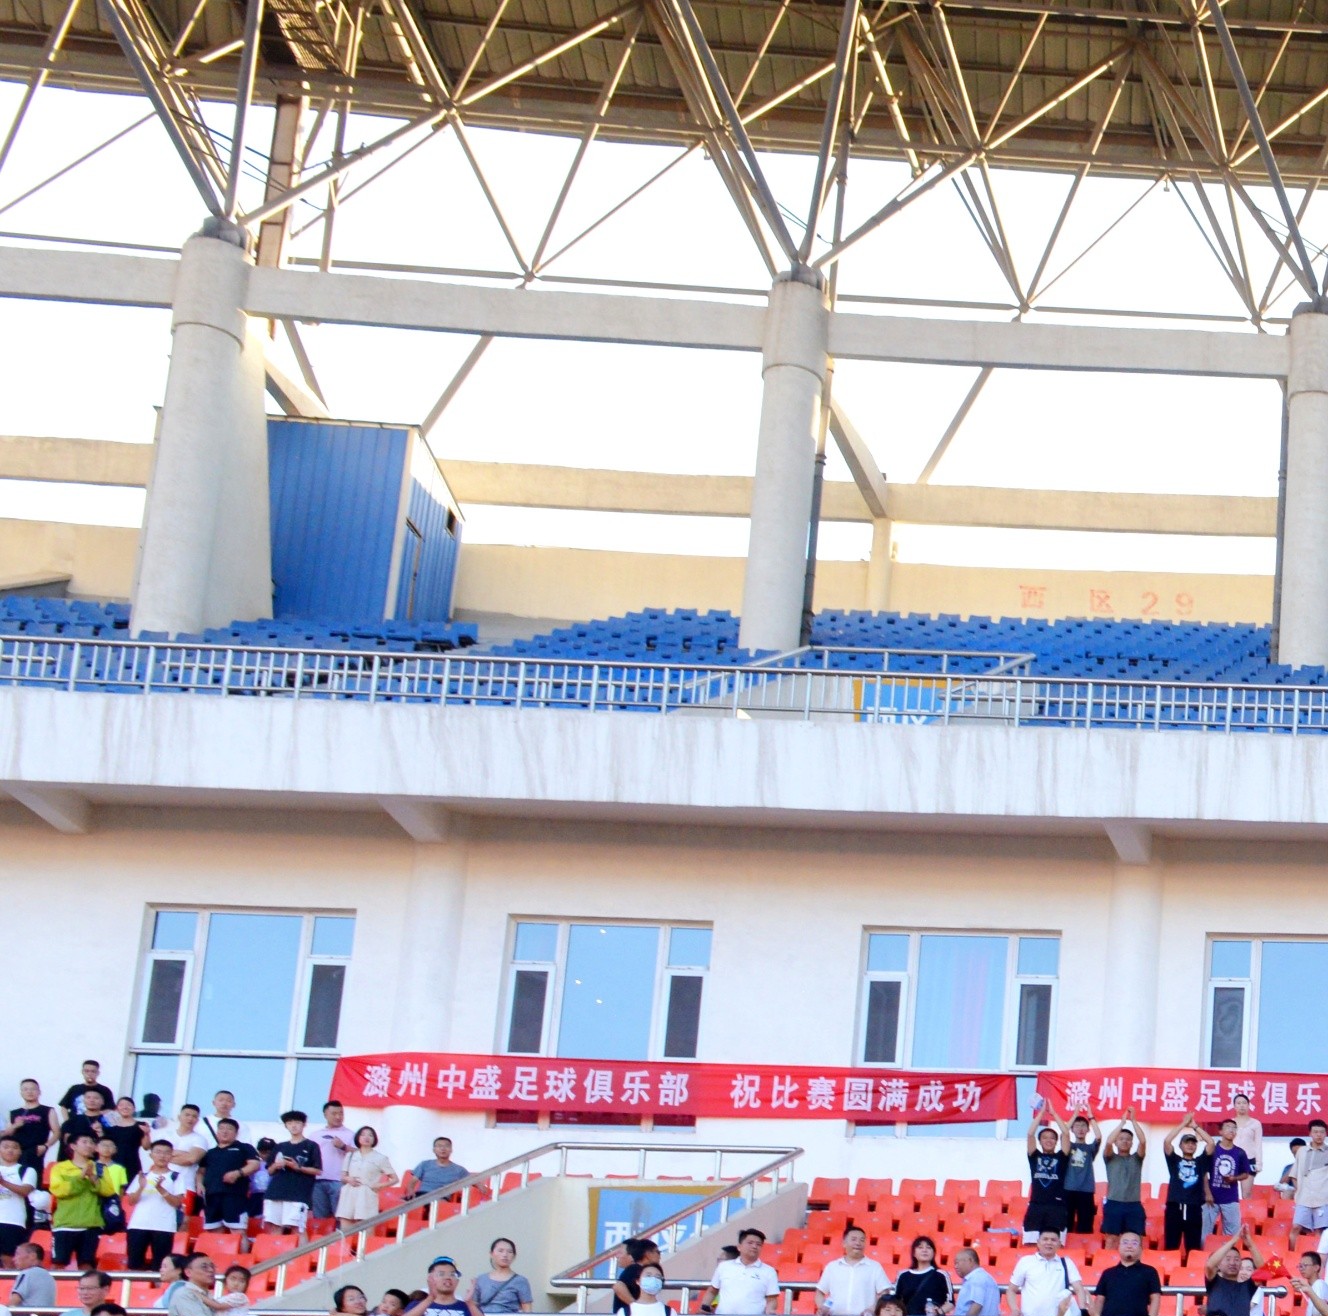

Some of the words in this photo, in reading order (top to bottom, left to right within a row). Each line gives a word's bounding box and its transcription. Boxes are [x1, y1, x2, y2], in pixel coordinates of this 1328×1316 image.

[362, 1062, 689, 1107] 潞州中盛足球俱乐部
[730, 1072, 982, 1113] 祝比赛圆满成功
